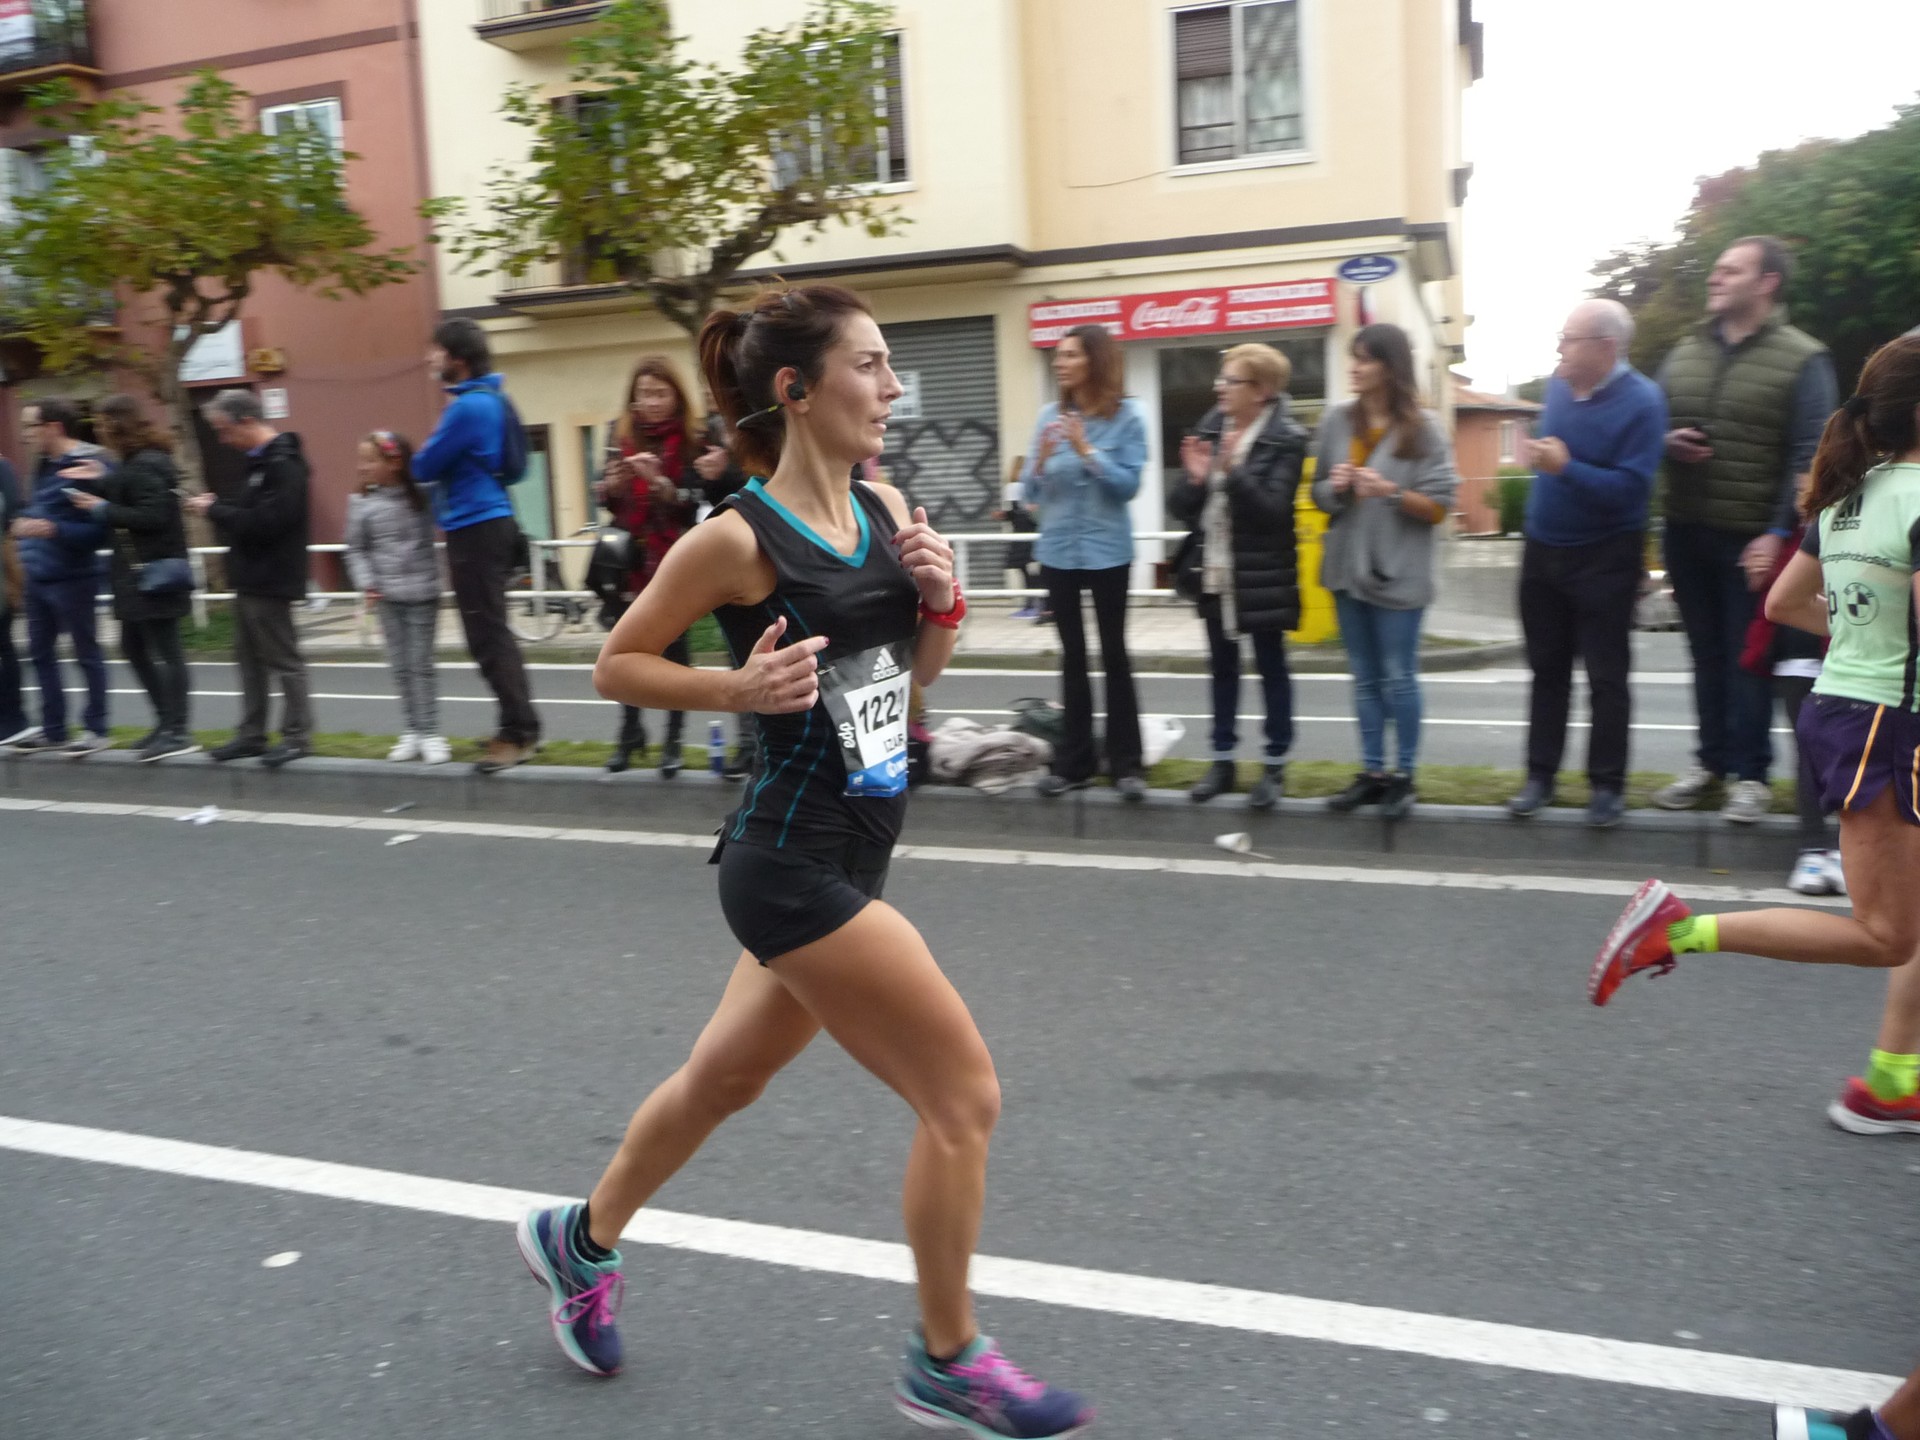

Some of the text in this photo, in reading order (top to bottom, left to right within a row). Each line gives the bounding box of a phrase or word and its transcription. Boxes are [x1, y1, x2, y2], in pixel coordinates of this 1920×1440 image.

[1832, 519, 1861, 532] adidas
[872, 665, 900, 681] adidas
[838, 721, 856, 749] edp
